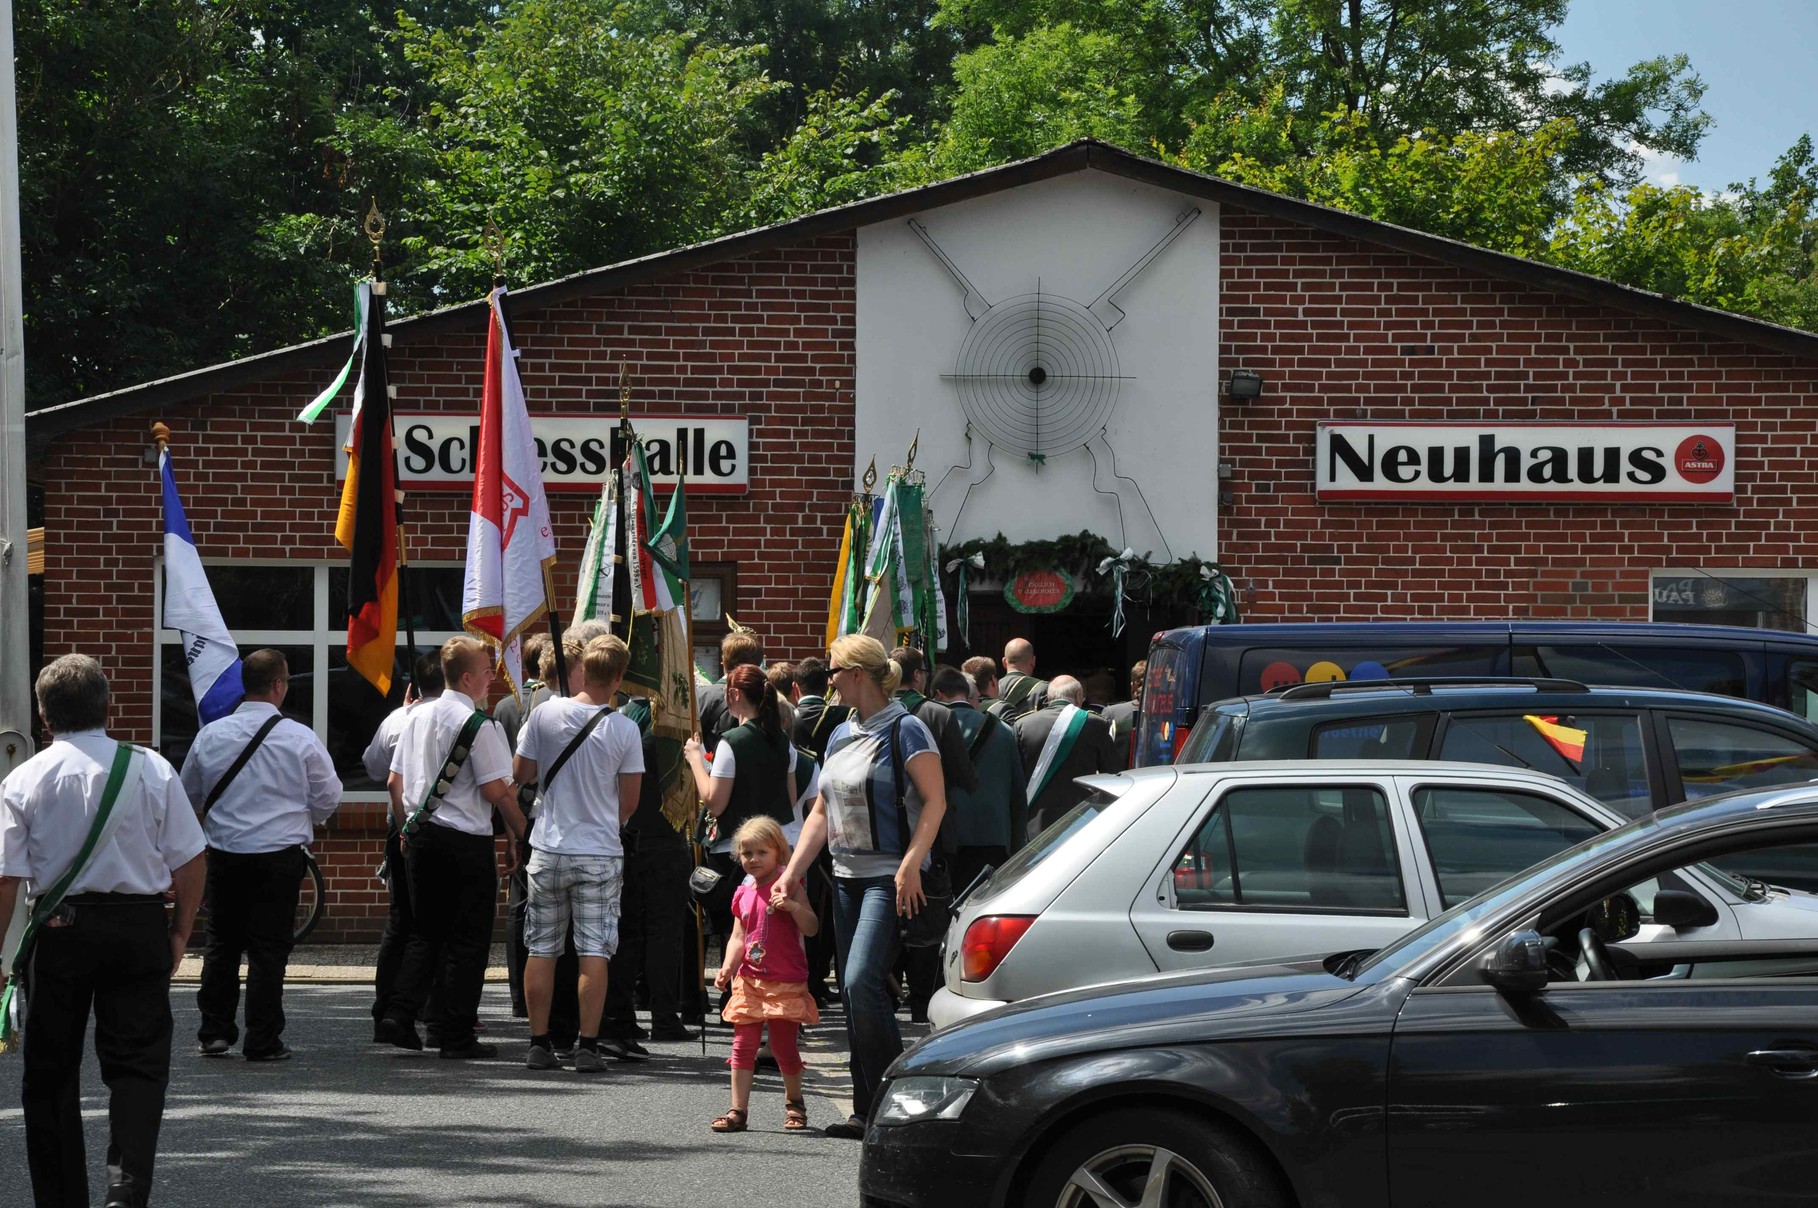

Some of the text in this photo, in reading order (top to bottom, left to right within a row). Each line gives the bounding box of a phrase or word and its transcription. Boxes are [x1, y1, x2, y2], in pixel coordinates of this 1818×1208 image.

[404, 424, 737, 477] Scssalle
[1329, 433, 1667, 485] Neuhaus
[1684, 461, 1714, 469] ASTRA
